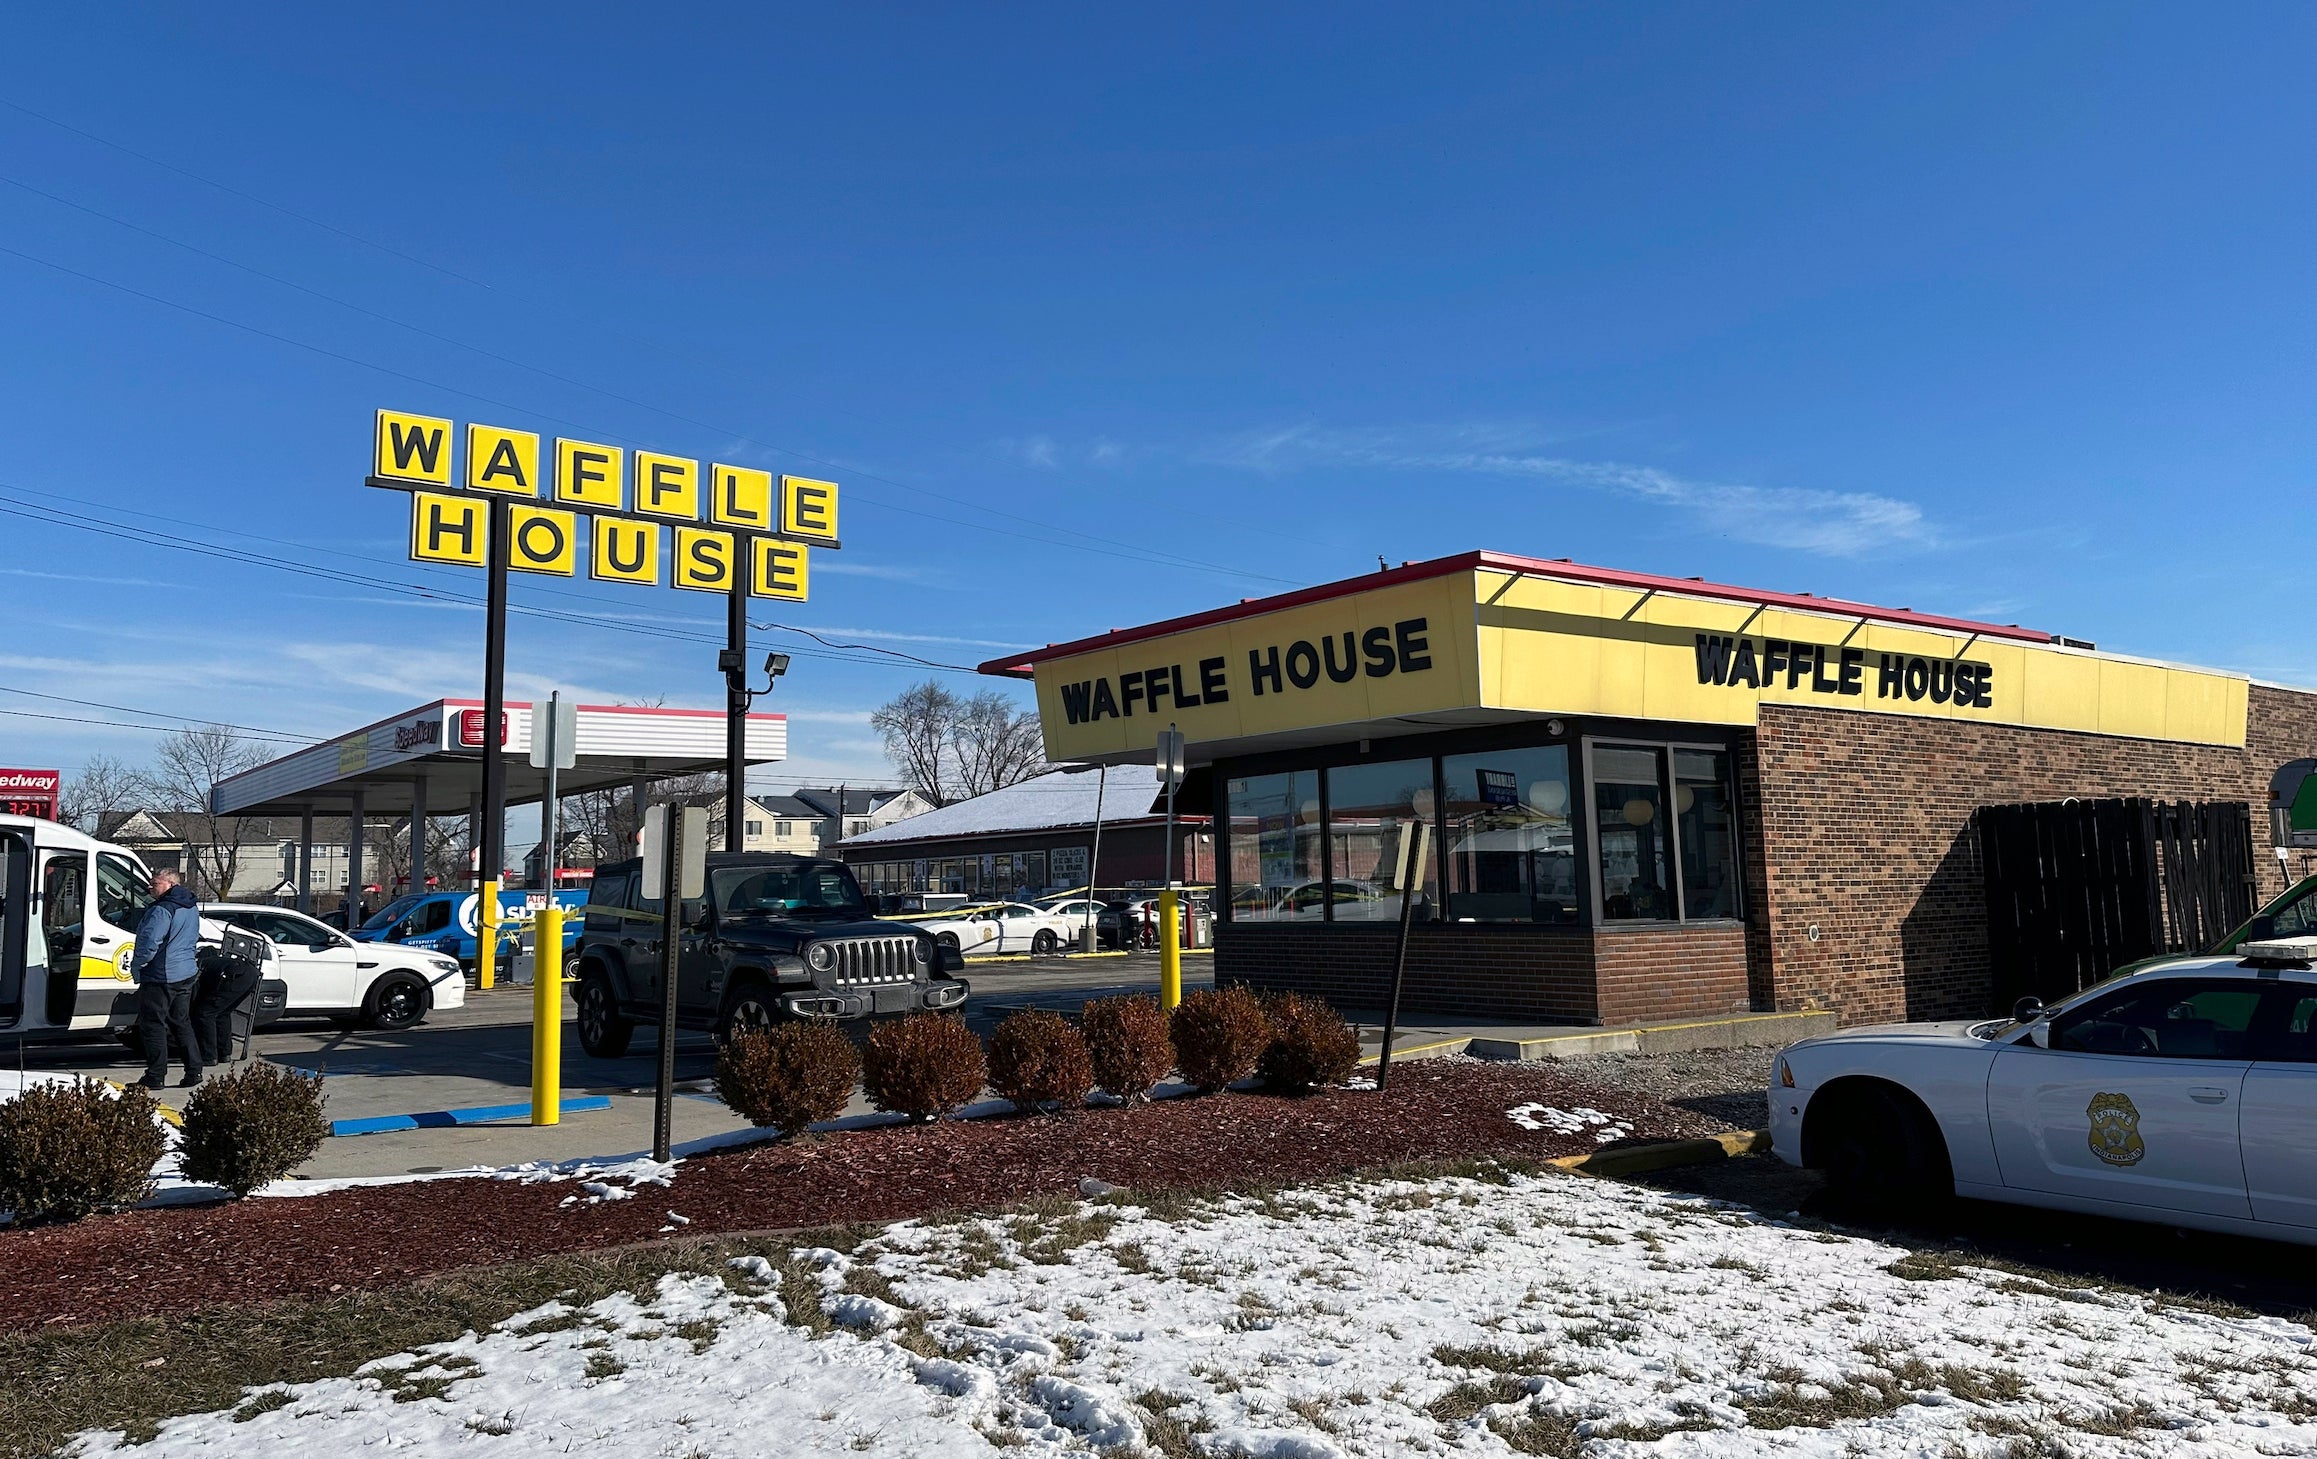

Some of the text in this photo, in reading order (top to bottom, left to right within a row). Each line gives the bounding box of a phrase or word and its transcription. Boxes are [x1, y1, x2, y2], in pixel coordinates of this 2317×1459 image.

[390, 422, 827, 530] WAFFLE
[428, 504, 798, 591] HOUSE
[1061, 617, 1433, 725] WAFFLE HOUSE
[1694, 633, 1993, 709] WAFFLE HOUSE
[528, 895, 546, 904] AIR
[2092, 1145, 2142, 1160] INDIANAPOLIS
[2097, 1110, 2132, 1124] POLICE
